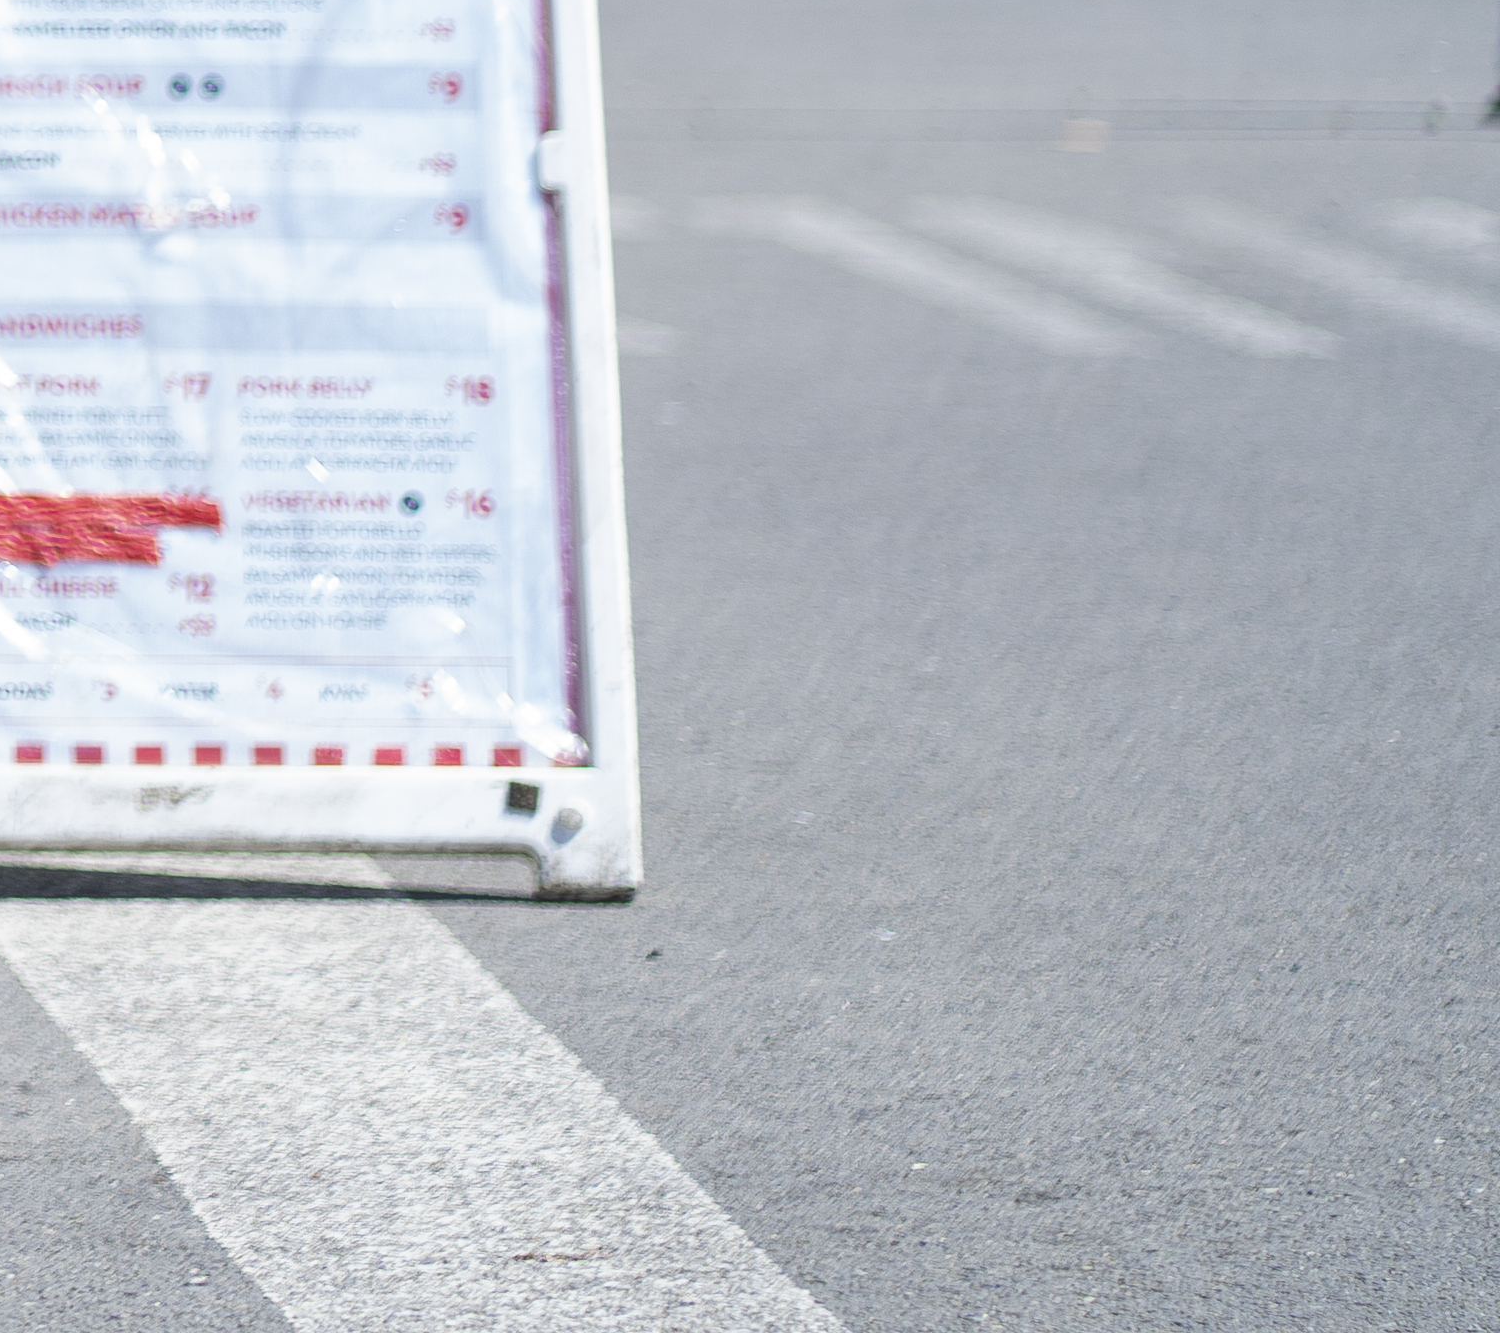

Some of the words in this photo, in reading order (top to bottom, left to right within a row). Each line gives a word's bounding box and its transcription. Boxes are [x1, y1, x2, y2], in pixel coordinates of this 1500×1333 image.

[115, 18, 180, 41] ONION
[182, 18, 222, 41] AND
[223, 18, 287, 41] BACON
[72, 73, 147, 101] SOUP
[426, 71, 465, 105] $9
[187, 200, 260, 230] SOUP
[433, 201, 470, 236] $9
[35, 372, 104, 397] PORK
[238, 374, 304, 401] PORK
[307, 374, 375, 401] BELLY
[443, 373, 496, 408] $18
[242, 489, 392, 515] VEGETARIAN
[445, 487, 496, 520] $16
[30, 573, 120, 600] CHEESE
